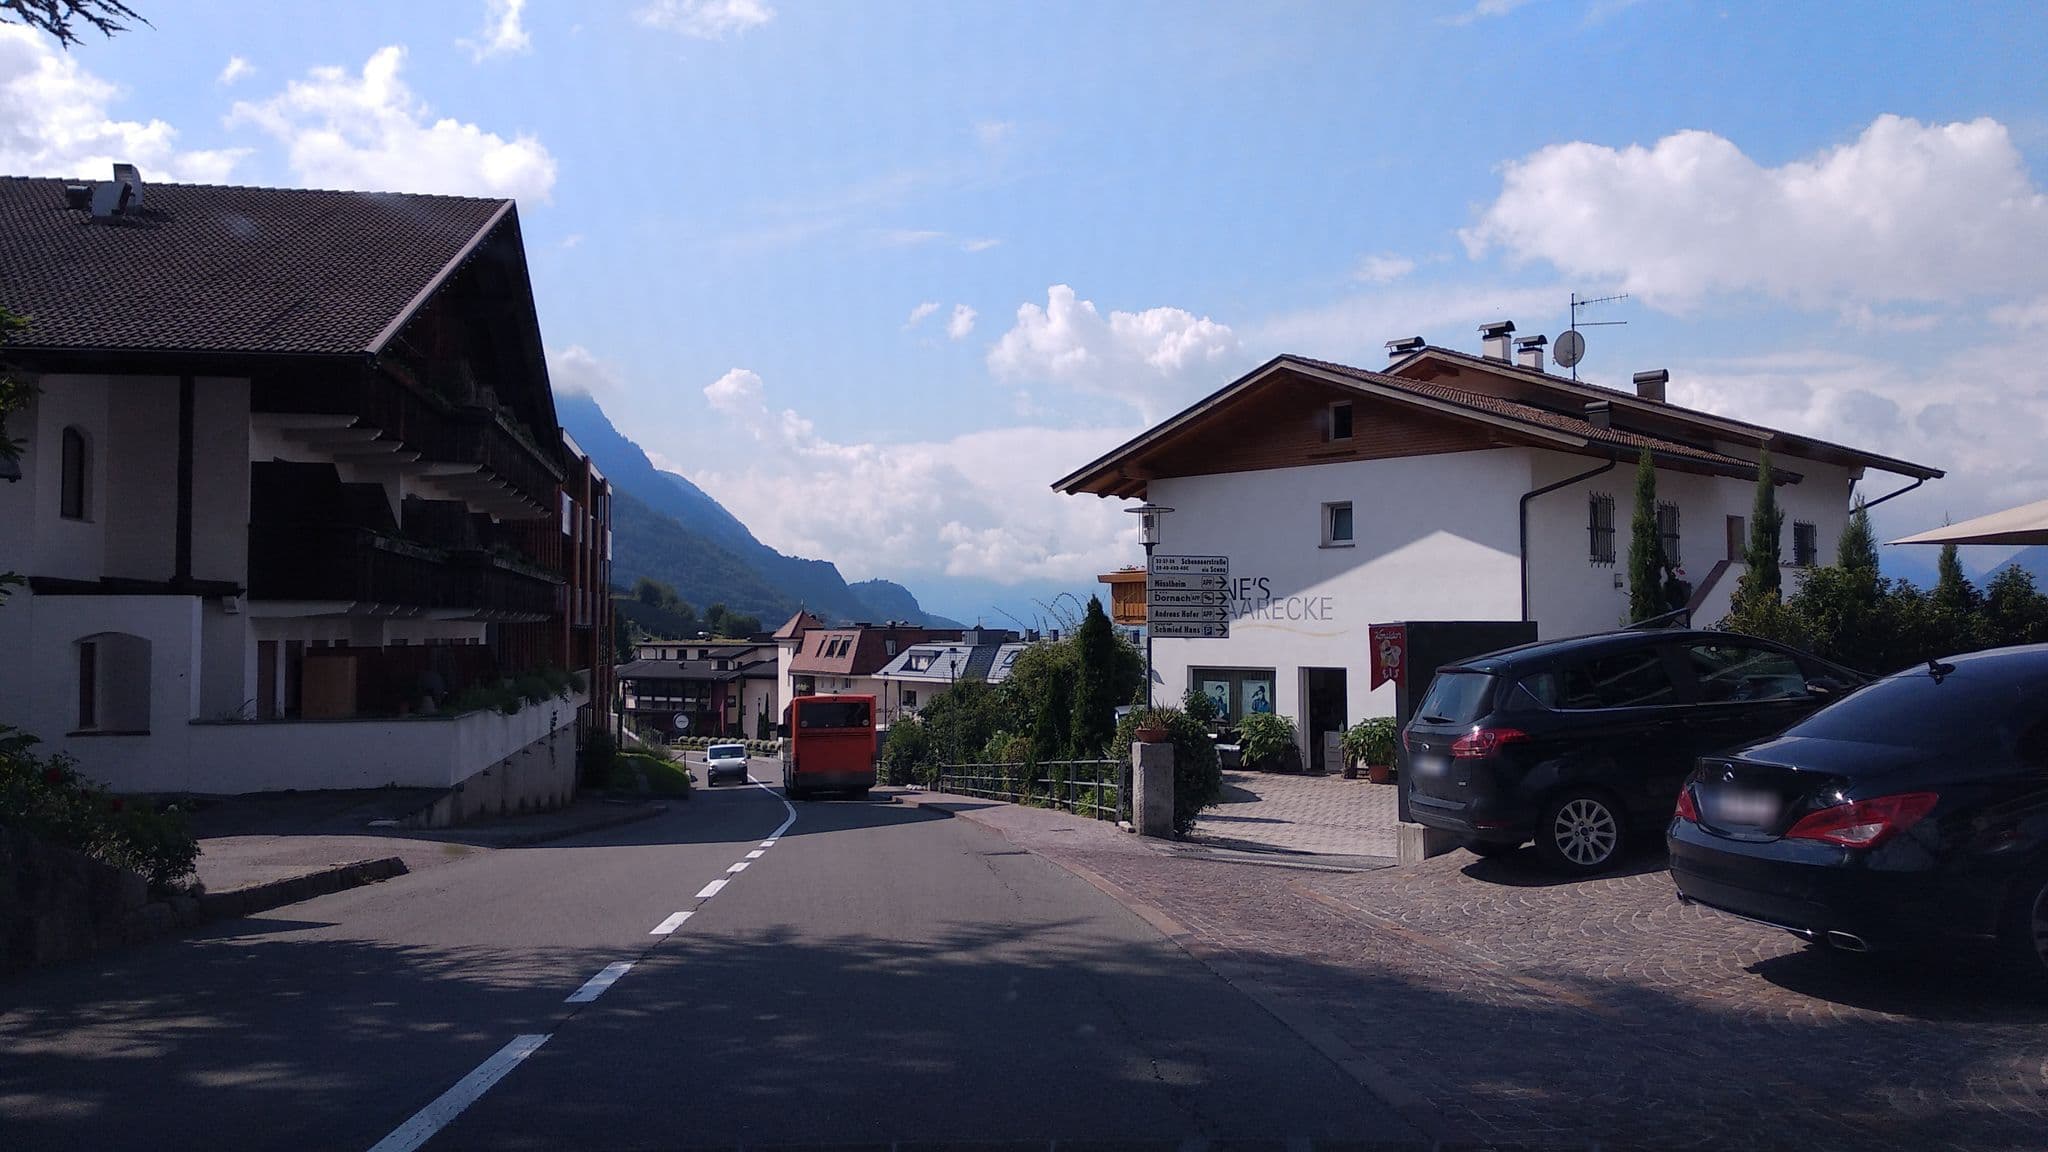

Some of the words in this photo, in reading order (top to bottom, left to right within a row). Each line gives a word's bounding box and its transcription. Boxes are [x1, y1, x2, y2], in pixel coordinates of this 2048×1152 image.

[1154, 594, 1191, 602] Dornach
[1155, 610, 1180, 618] Andreas
[1154, 625, 1183, 633] Schmied
